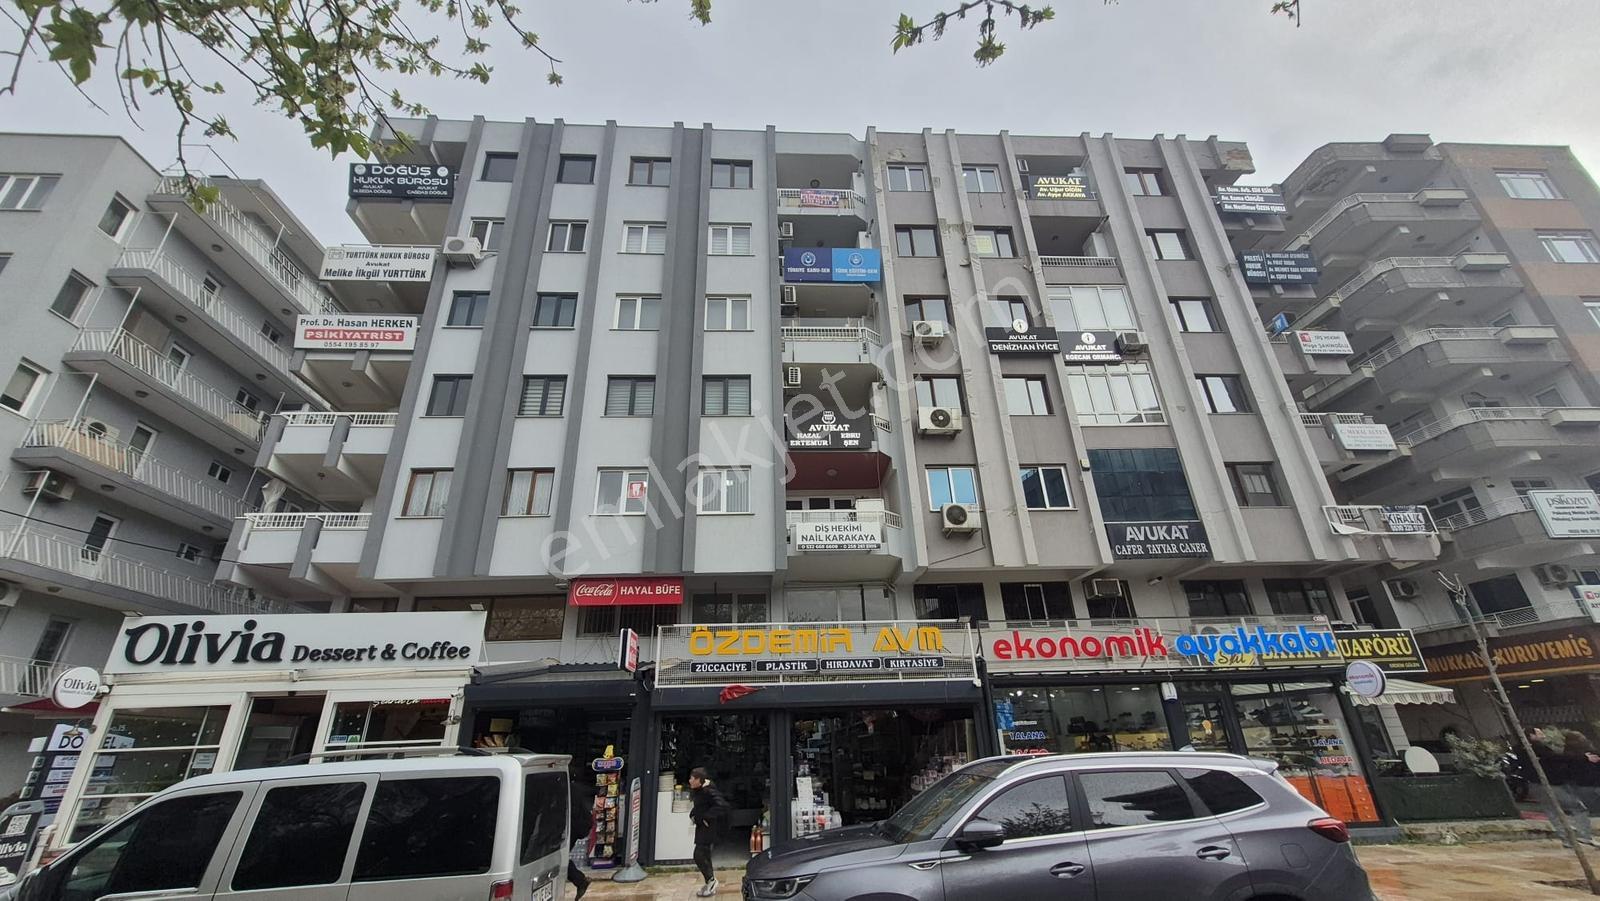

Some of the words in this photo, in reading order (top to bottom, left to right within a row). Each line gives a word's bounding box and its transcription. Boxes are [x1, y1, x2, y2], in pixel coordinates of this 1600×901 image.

[371, 164, 431, 177] DOĞUŞ
[353, 177, 395, 185] HUKUK
[397, 177, 449, 186] BÜROSU
[1037, 177, 1082, 185] AVUKAT
[346, 250, 378, 259] YURTTÜRK
[380, 250, 402, 259] HUKUK
[404, 250, 431, 260] BÜROSU
[324, 268, 353, 277] Melike
[355, 267, 380, 280] İlkgül
[383, 268, 427, 279] YURTTÜRK
[301, 318, 320, 326] Prof.
[323, 318, 334, 326] Dr.
[337, 318, 368, 328] Hasan
[371, 319, 413, 328] HERKEN
[306, 329, 403, 340] PSİKİYATRİST
[992, 342, 1036, 351] DENİZHAN
[1036, 341, 1059, 351] İYİCE
[809, 424, 850, 432] AVUKAT
[790, 439, 829, 447] ERTEMUR
[843, 439, 860, 448] ŞEN
[814, 524, 830, 533] DİŞ
[831, 523, 862, 532] HEKİMİ
[1126, 525, 1189, 541] AVUKAT
[801, 533, 823, 542] NAİL
[825, 534, 877, 542] KARAKAYA
[1115, 544, 1145, 555] CAFER
[1146, 543, 1179, 554] TAYYAR
[1179, 542, 1209, 553] CANER
[620, 585, 654, 595] HAYAL
[655, 584, 681, 595] BÜFE
[124, 619, 285, 665] Olivia
[291, 644, 378, 663] Dessert
[380, 643, 398, 661] &
[401, 641, 471, 661] Coffee
[872, 626, 945, 653] AVM
[994, 628, 1168, 660] ekonomik
[1175, 624, 1337, 663] ayakkabı
[1329, 633, 1413, 657] UAFÖRÜ
[1494, 634, 1593, 666] KURUYEMİŞ
[695, 661, 747, 672] ZÜCCACİYE
[766, 660, 808, 671] PLASTİK
[826, 658, 874, 669] HIRDAVAT
[890, 657, 939, 668] KIRTASİYE
[64, 678, 98, 691] Olivia
[0, 841, 28, 855] livia
